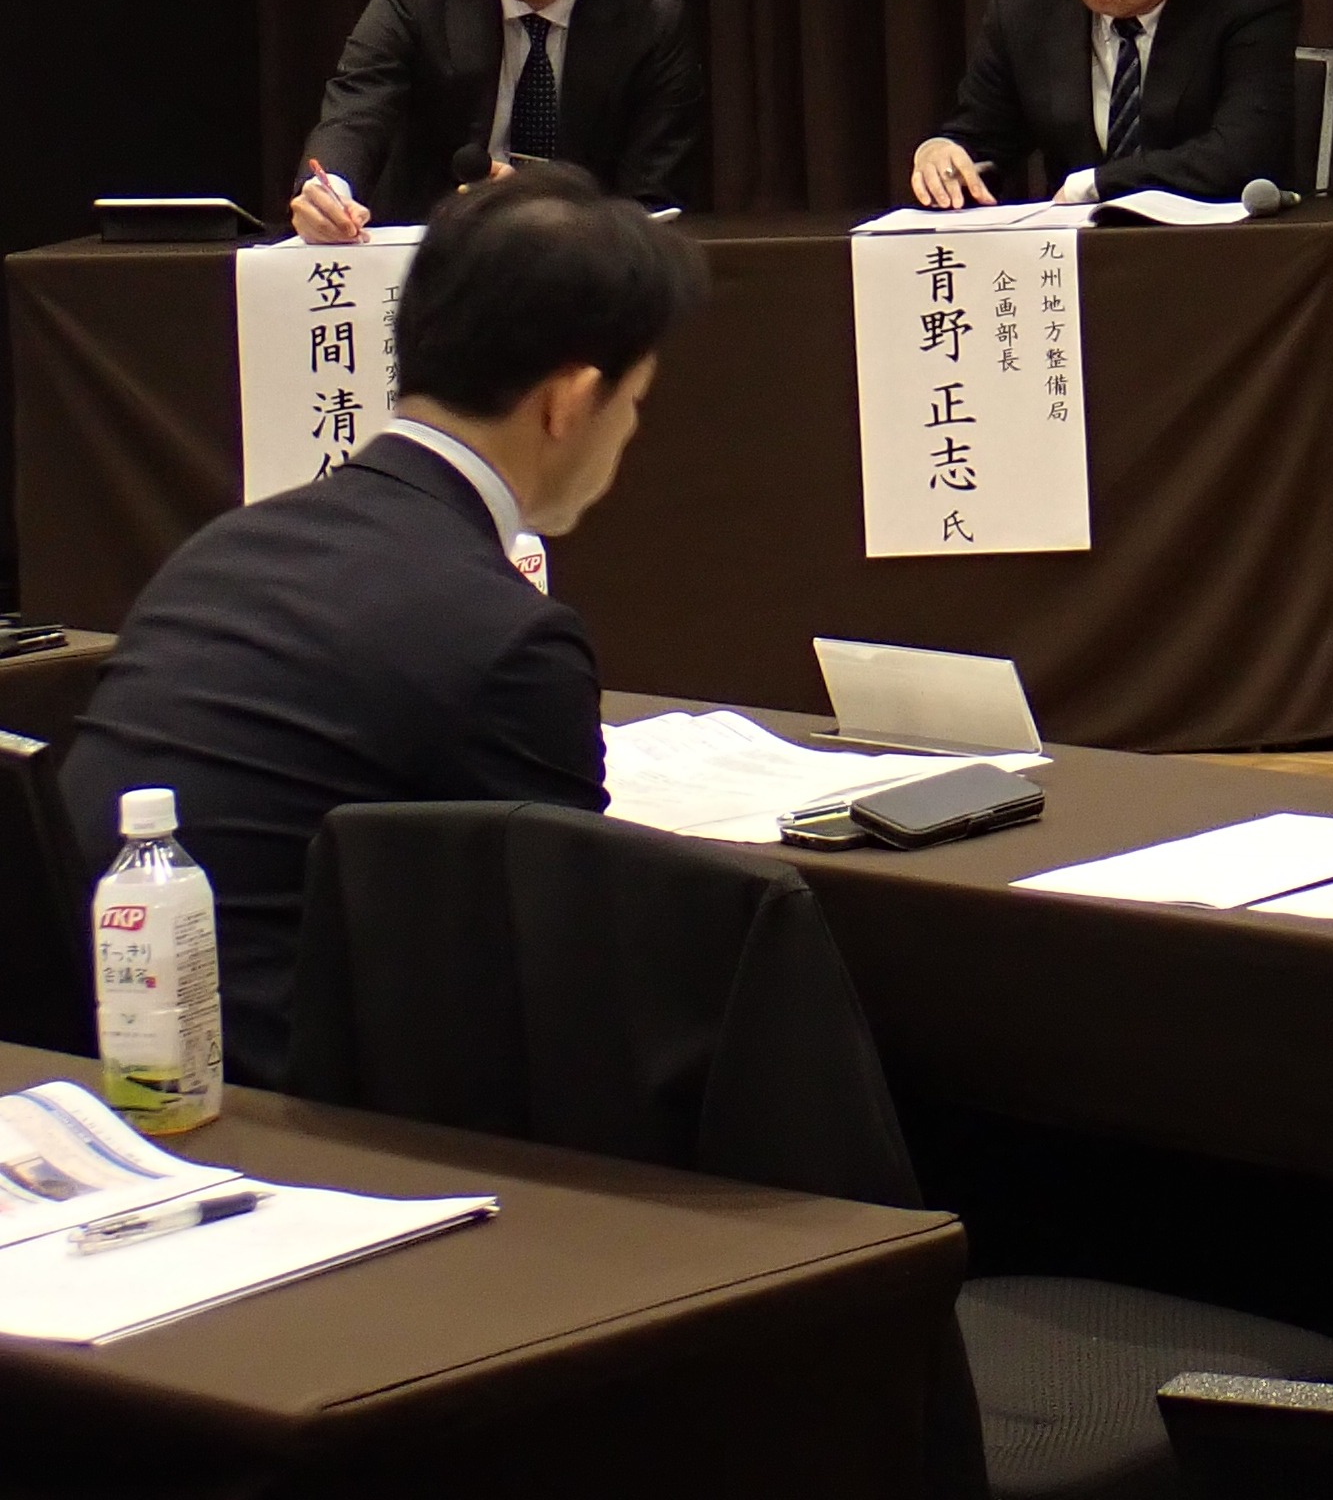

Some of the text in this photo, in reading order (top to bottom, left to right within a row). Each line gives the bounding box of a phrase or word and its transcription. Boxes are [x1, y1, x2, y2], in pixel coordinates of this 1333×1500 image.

[992, 270, 1021, 372] 企画部長
[1039, 241, 1069, 422] 九州地方整備局
[101, 908, 145, 928] TKP
